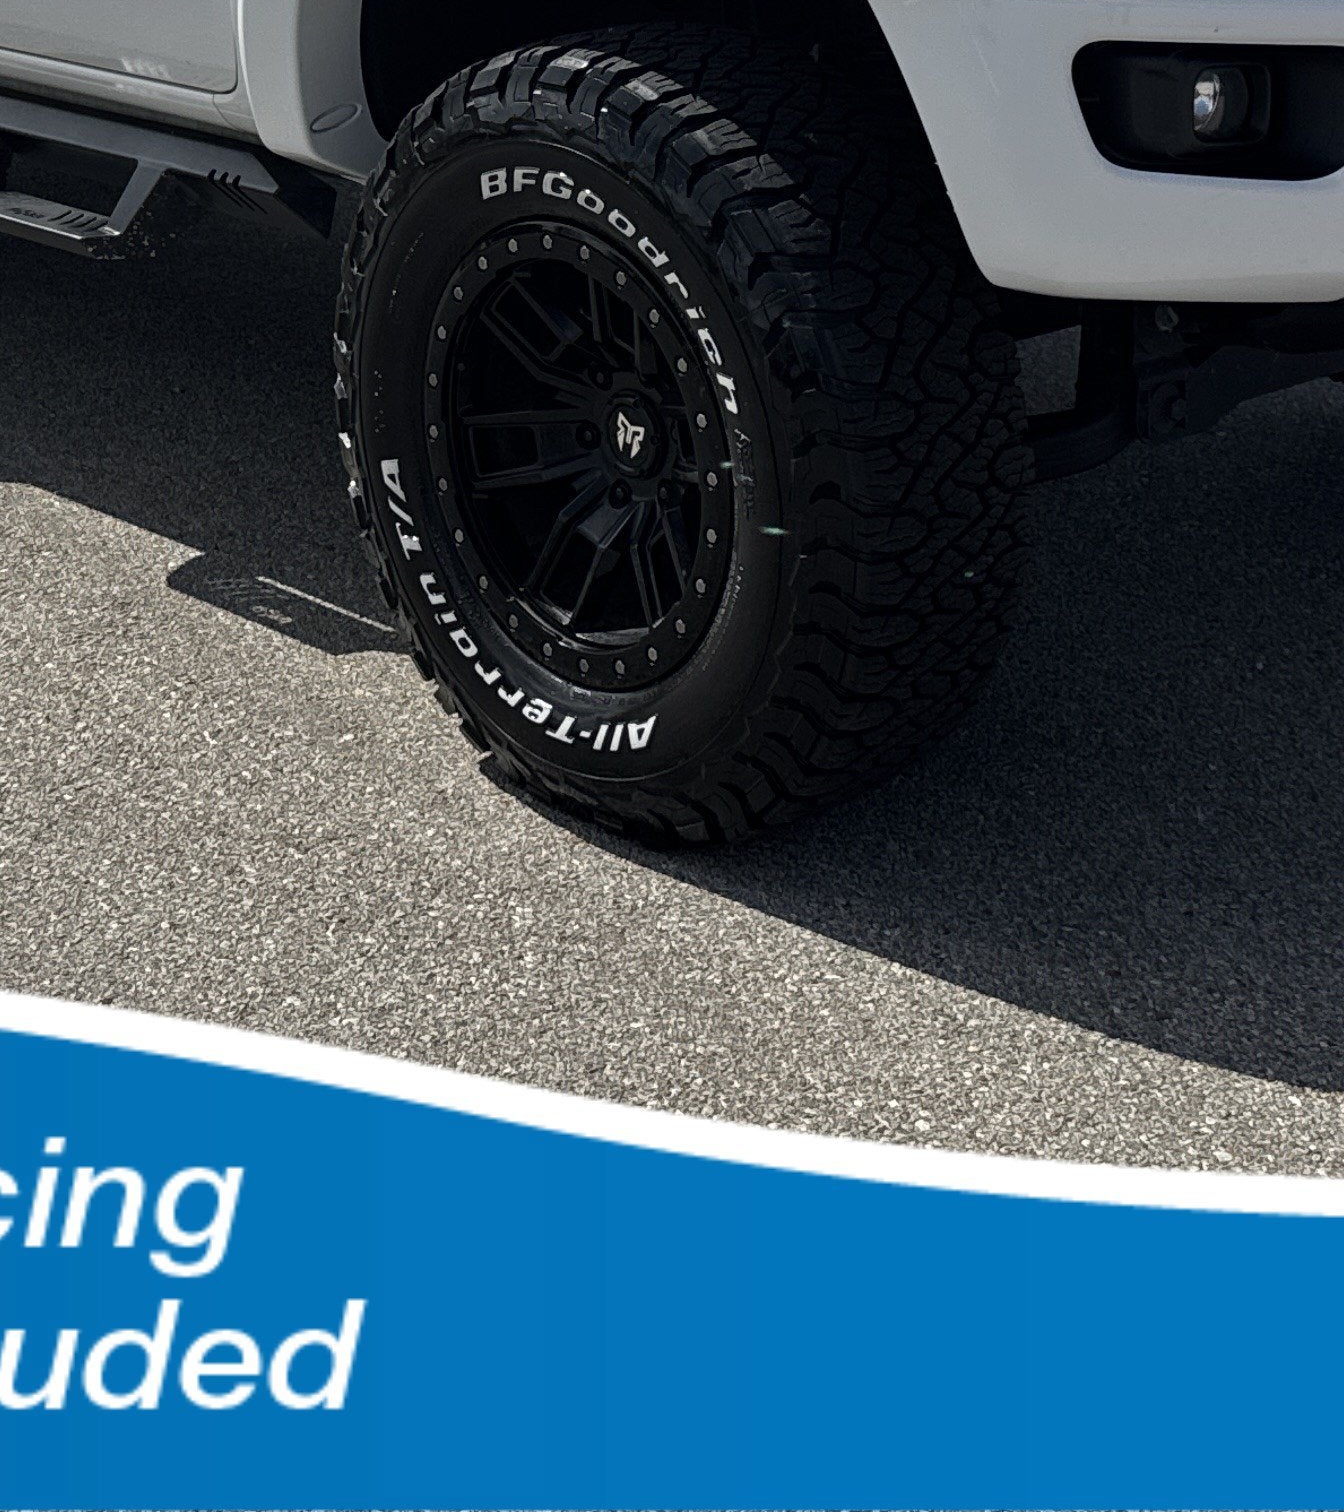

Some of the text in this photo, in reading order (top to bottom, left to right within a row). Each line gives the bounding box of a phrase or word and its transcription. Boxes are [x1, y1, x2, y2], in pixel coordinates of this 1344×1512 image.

[480, 167, 738, 414] BFGoodrich
[380, 458, 422, 561] T/A
[419, 572, 657, 752] All-Terrain
